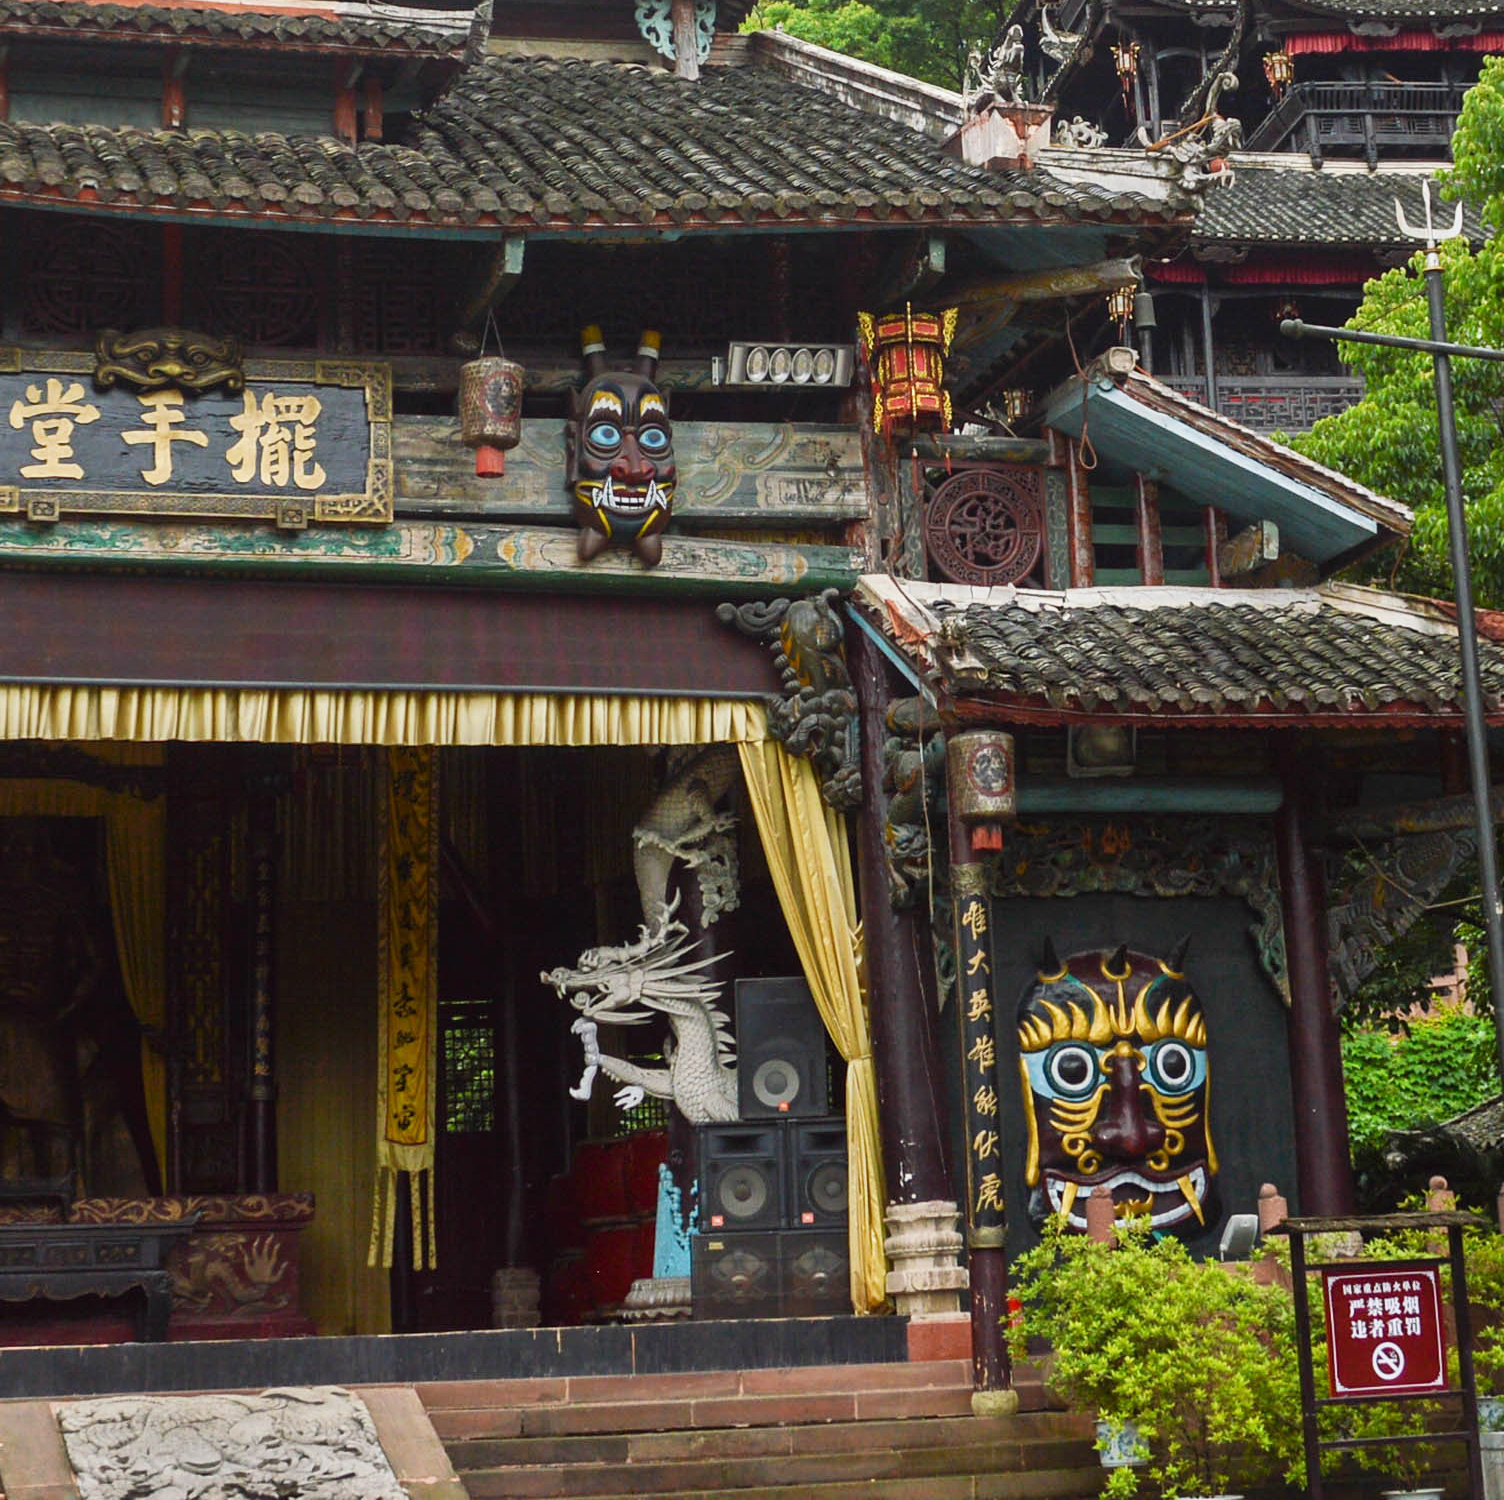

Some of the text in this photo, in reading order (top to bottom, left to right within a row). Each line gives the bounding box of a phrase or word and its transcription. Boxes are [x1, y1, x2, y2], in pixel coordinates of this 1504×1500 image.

[1342, 1280, 1421, 1295] 国家重点防火单位
[1349, 1295, 1420, 1318] 严禁吸烟
[1350, 1316, 1422, 1339] 违者重罚
